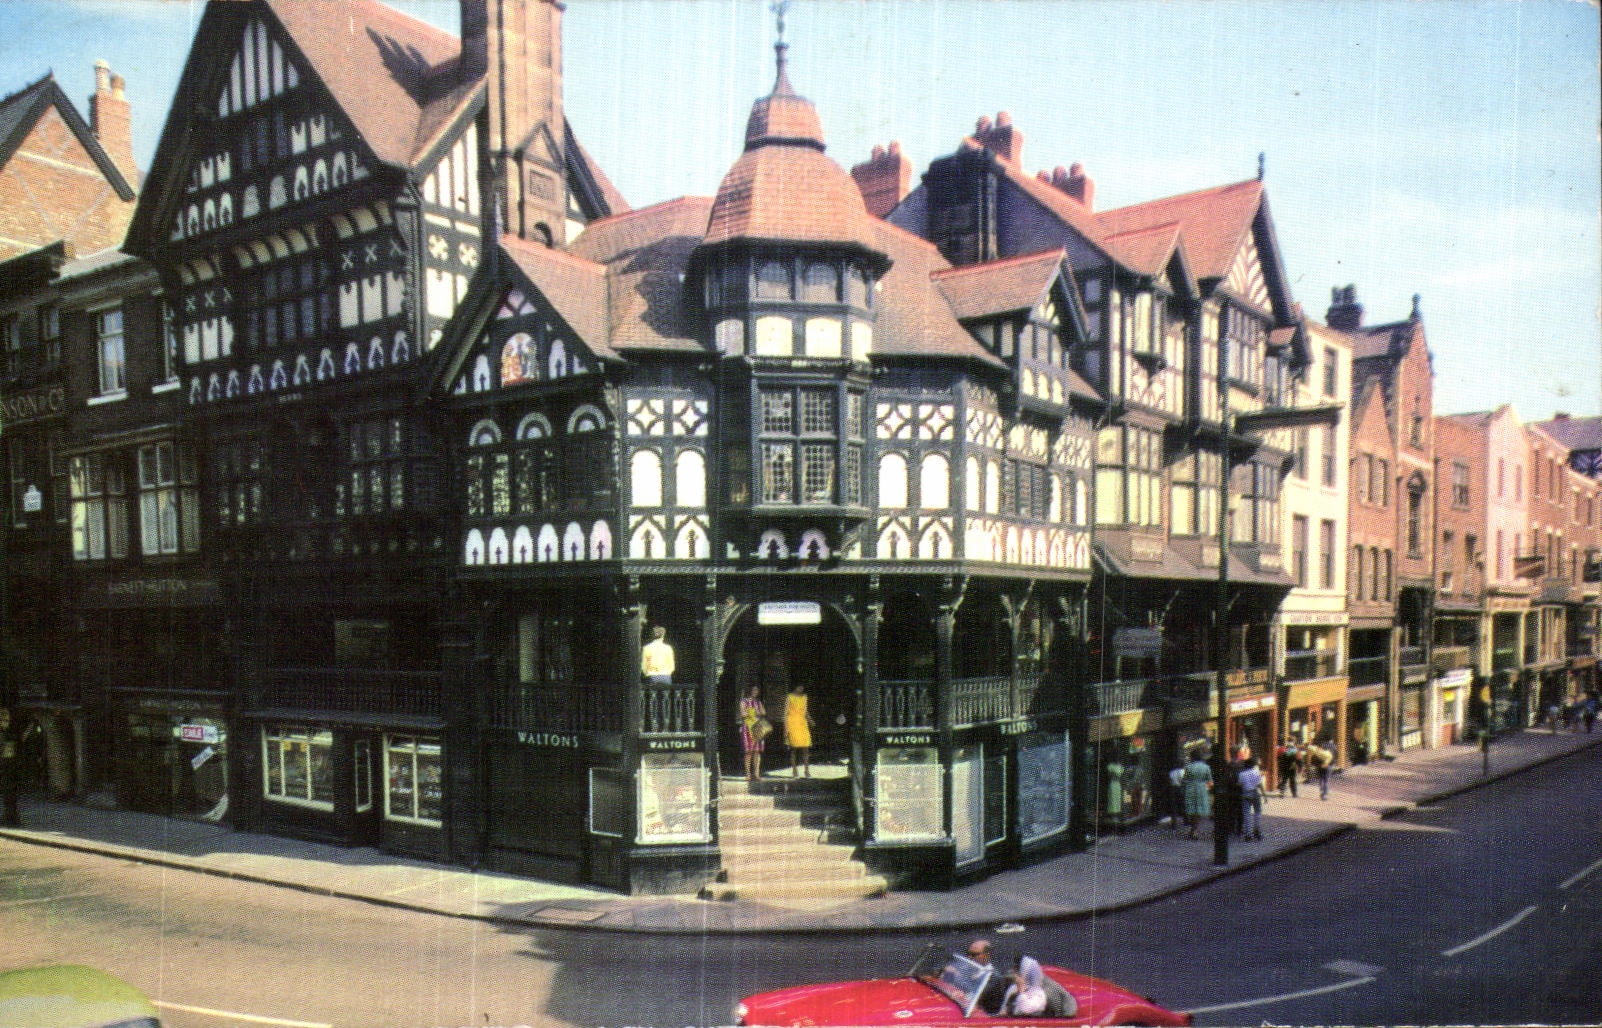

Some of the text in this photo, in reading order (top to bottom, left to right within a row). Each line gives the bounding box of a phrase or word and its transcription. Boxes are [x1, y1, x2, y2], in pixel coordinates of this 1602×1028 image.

[517, 731, 579, 748] WALTONS
[886, 735, 931, 744] WALTONS
[649, 740, 696, 749] WALTONS
